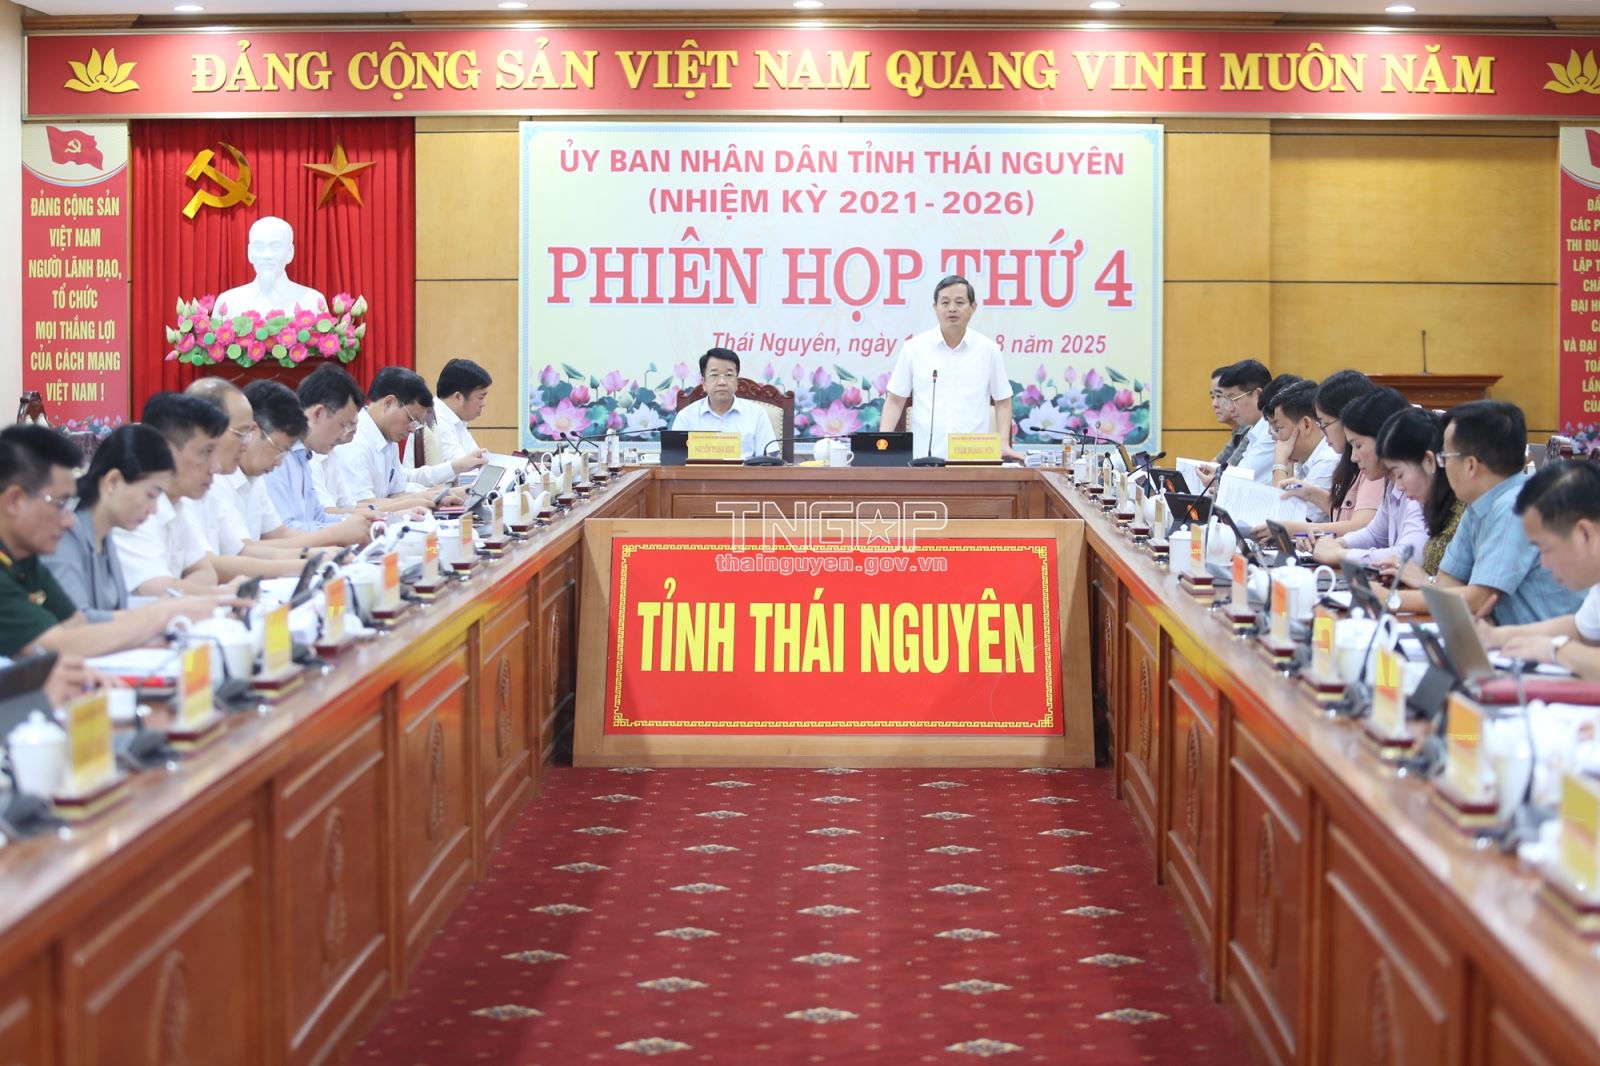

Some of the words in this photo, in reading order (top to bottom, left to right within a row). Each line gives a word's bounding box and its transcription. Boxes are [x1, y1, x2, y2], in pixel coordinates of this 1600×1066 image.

[192, 40, 332, 93] ĐẢNG
[348, 41, 482, 101] CỘNG
[496, 37, 598, 90] SẢN
[615, 39, 738, 99] VIỆT
[754, 50, 871, 90] NAM
[886, 49, 1060, 97] QUANG
[1072, 51, 1206, 91] VINH
[1220, 42, 1366, 92] MUÔN
[1381, 44, 1495, 94] NĂM
[560, 139, 600, 173] ỦY
[610, 149, 670, 172] BAN
[681, 144, 763, 173] NHÂN
[775, 144, 837, 173] DÂN
[848, 140, 914, 173] TỈNH
[925, 145, 990, 174] THÁI
[1002, 146, 1124, 175] NGUYÊN
[31, 189, 60, 216] ĐẢNG
[64, 193, 93, 220] CỘNG
[97, 189, 119, 216] SẢN
[649, 182, 768, 220] (NHIỆM
[783, 183, 828, 213] KỲ
[839, 190, 917, 214] 2021
[942, 190, 1034, 216] 2026)
[49, 224, 72, 251] VIỆT
[75, 228, 101, 247] NAM
[1585, 239, 1600, 252] ĐU
[29, 254, 62, 278] NGƯỜI
[65, 255, 93, 278] LÃNH
[96, 258, 122, 282] ĐẠO,
[547, 226, 763, 304] PHIÊN
[782, 246, 923, 323] HỌP
[941, 228, 1084, 308] THỨ
[1094, 249, 1132, 307] 4
[52, 282, 66, 309] TỔ
[69, 284, 98, 309] CHỨC
[35, 320, 56, 344] MỌI
[60, 314, 95, 340] THẮNG
[98, 319, 115, 344] LỢI
[713, 331, 754, 352] Thái
[760, 332, 840, 357] Nguyên,
[848, 332, 897, 357] ngày
[1011, 334, 1053, 353] năm
[1060, 335, 1107, 354] 2025
[30, 344, 52, 371] CỦA
[56, 347, 84, 371] CÁCH
[88, 351, 120, 375] MẠNG
[46, 378, 68, 406] VIỆT
[72, 382, 97, 402] NAM
[637, 577, 736, 672] TỈNH
[749, 587, 844, 673] THÁI
[860, 587, 1035, 673] NGUYÊN
